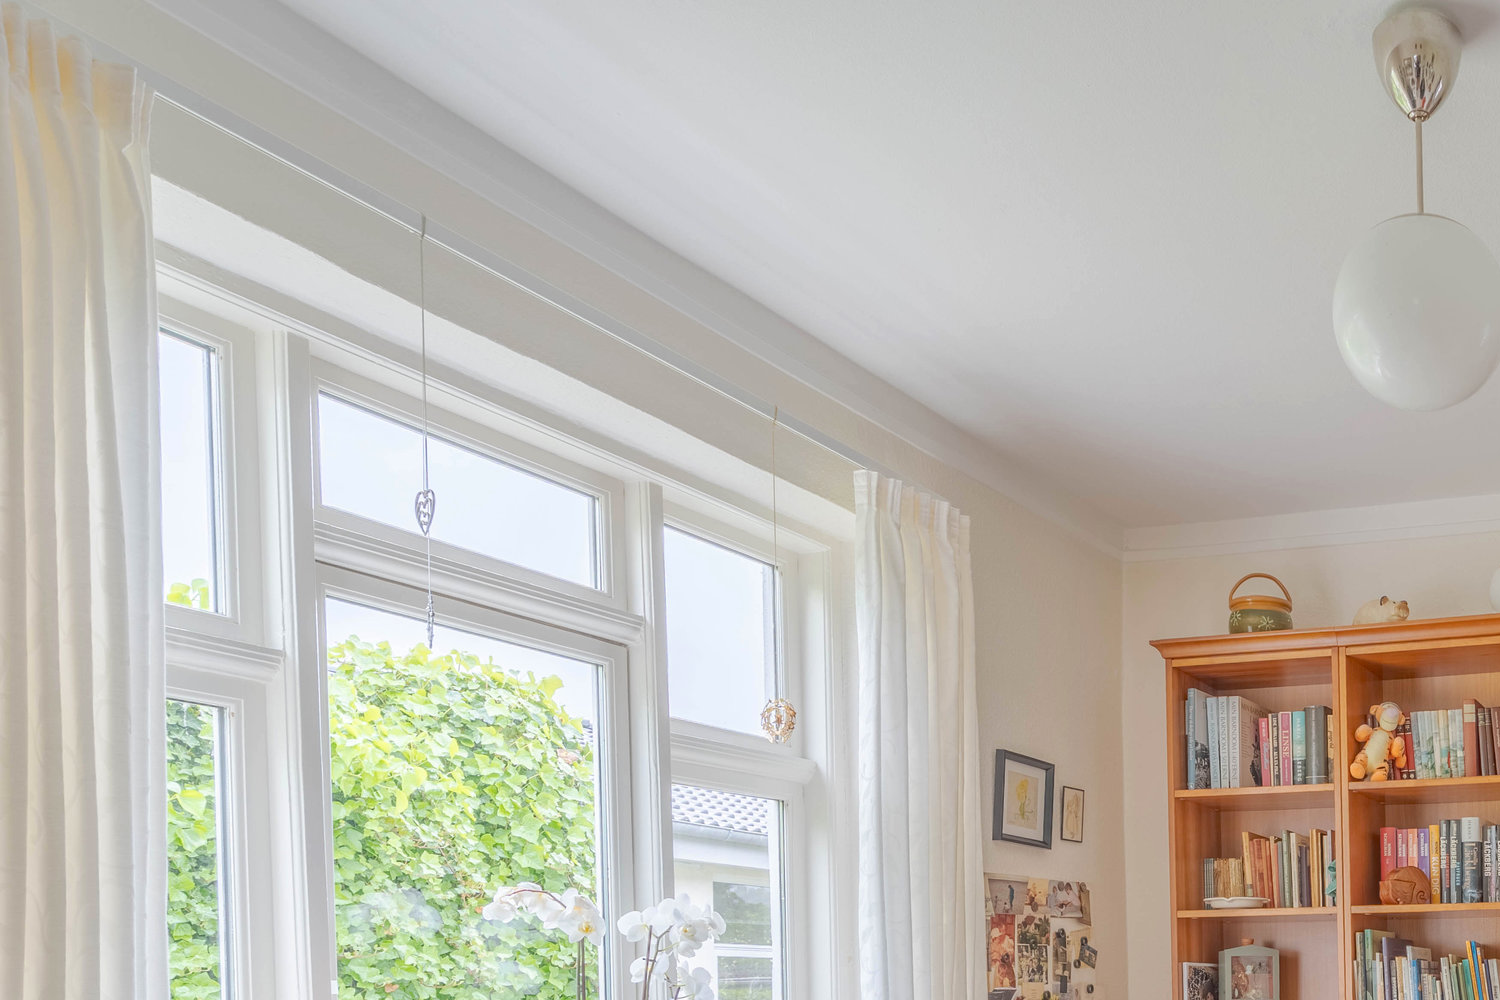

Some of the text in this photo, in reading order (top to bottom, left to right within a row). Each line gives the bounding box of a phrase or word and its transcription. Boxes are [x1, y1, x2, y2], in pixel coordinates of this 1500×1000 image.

[1282, 730, 1290, 758] LINSE
[1432, 857, 1440, 895] KUN DIG
[1484, 841, 1492, 877] LÄCKBERG
